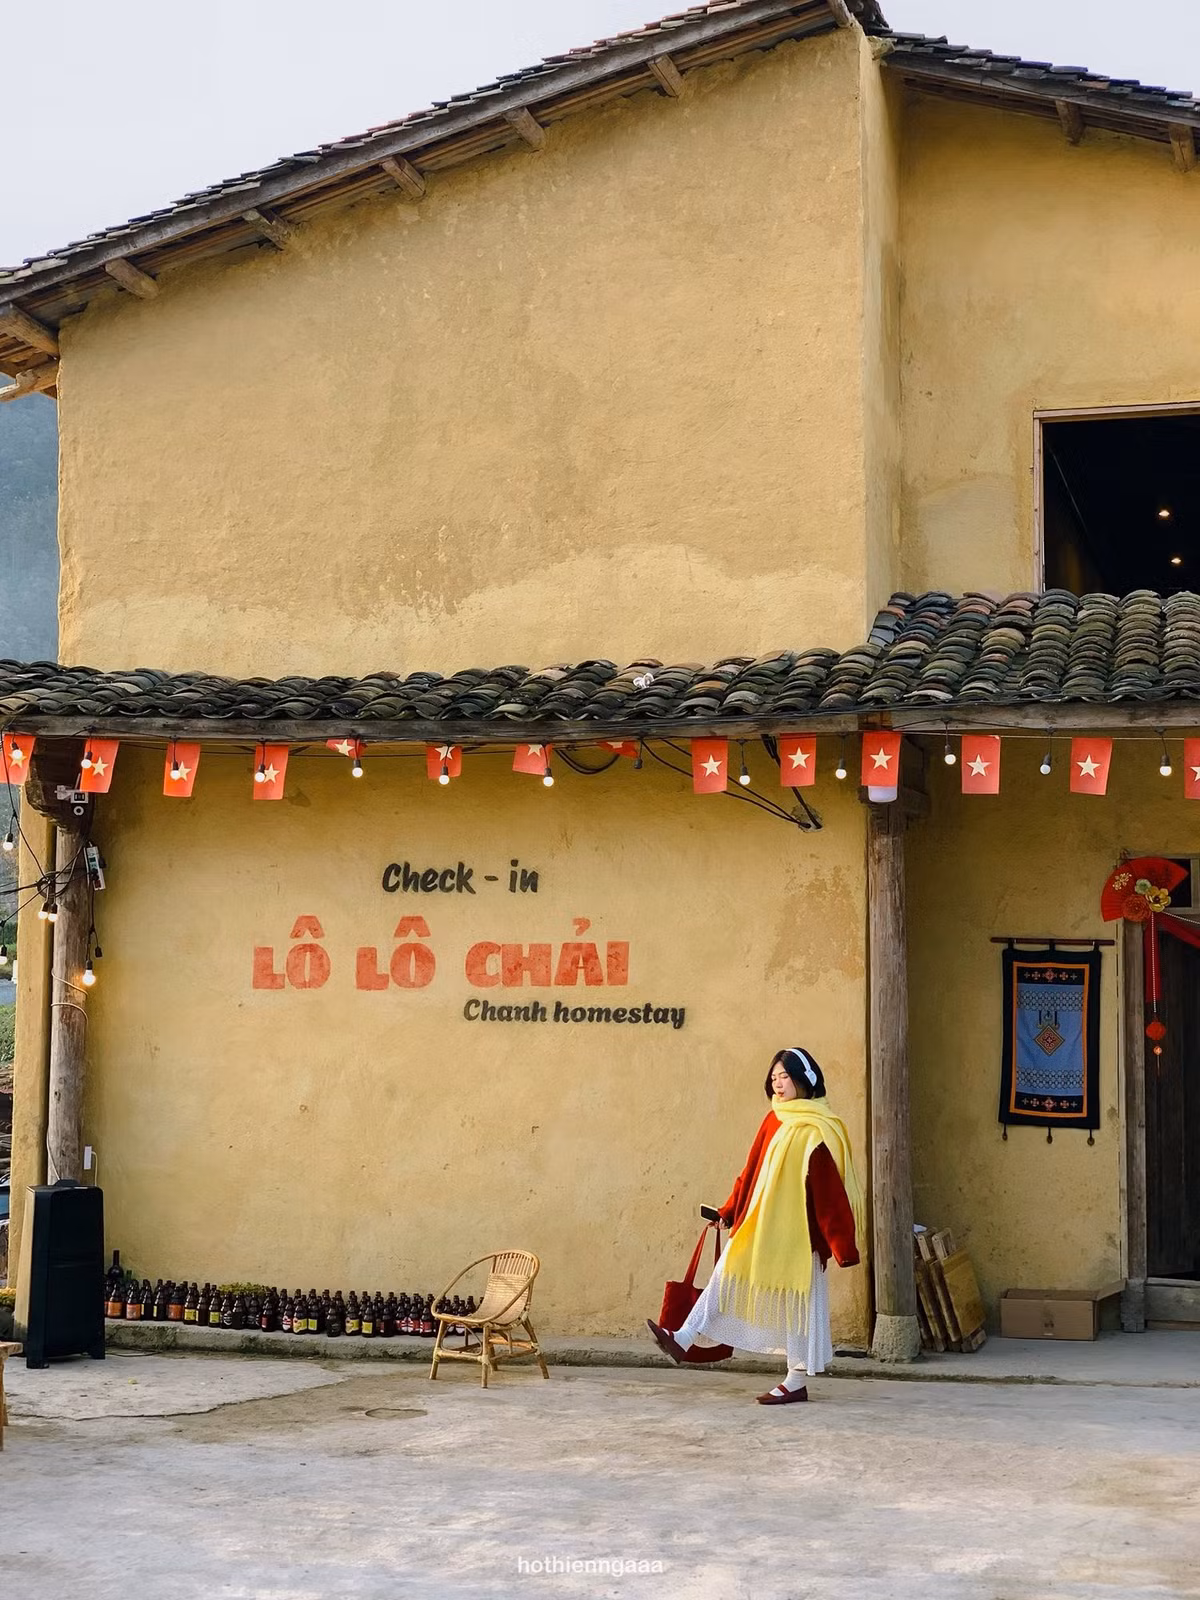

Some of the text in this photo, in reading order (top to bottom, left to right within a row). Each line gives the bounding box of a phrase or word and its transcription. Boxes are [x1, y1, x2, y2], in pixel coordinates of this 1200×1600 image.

[382, 862, 476, 894] Check
[508, 859, 540, 893] in
[252, 915, 630, 991] LÔ LÔ CHẢI
[463, 999, 686, 1030] Chanh homestay
